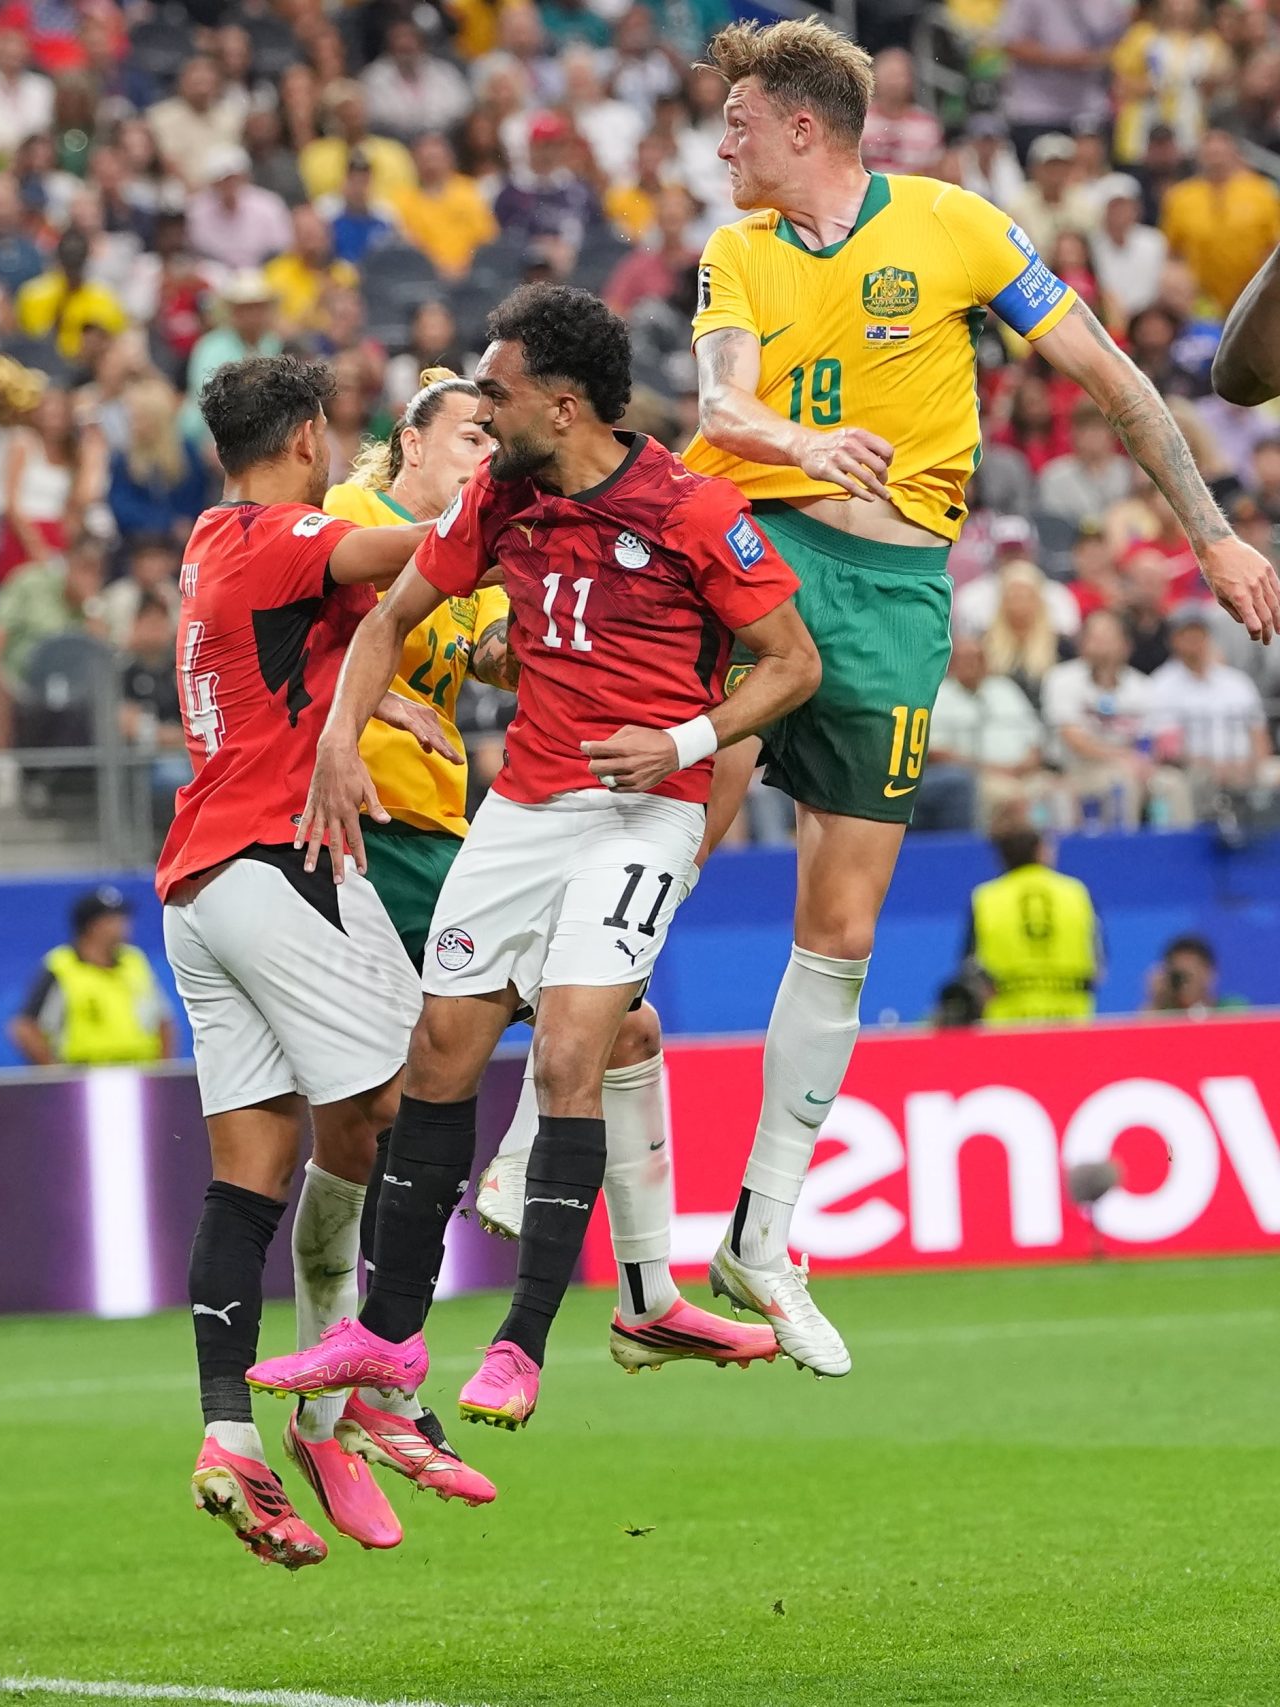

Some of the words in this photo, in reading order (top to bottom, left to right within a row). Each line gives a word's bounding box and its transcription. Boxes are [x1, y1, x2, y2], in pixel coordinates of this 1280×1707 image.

[789, 358, 842, 425] 19
[542, 572, 594, 652] 11
[888, 706, 929, 779] 19
[603, 863, 674, 938] 11
